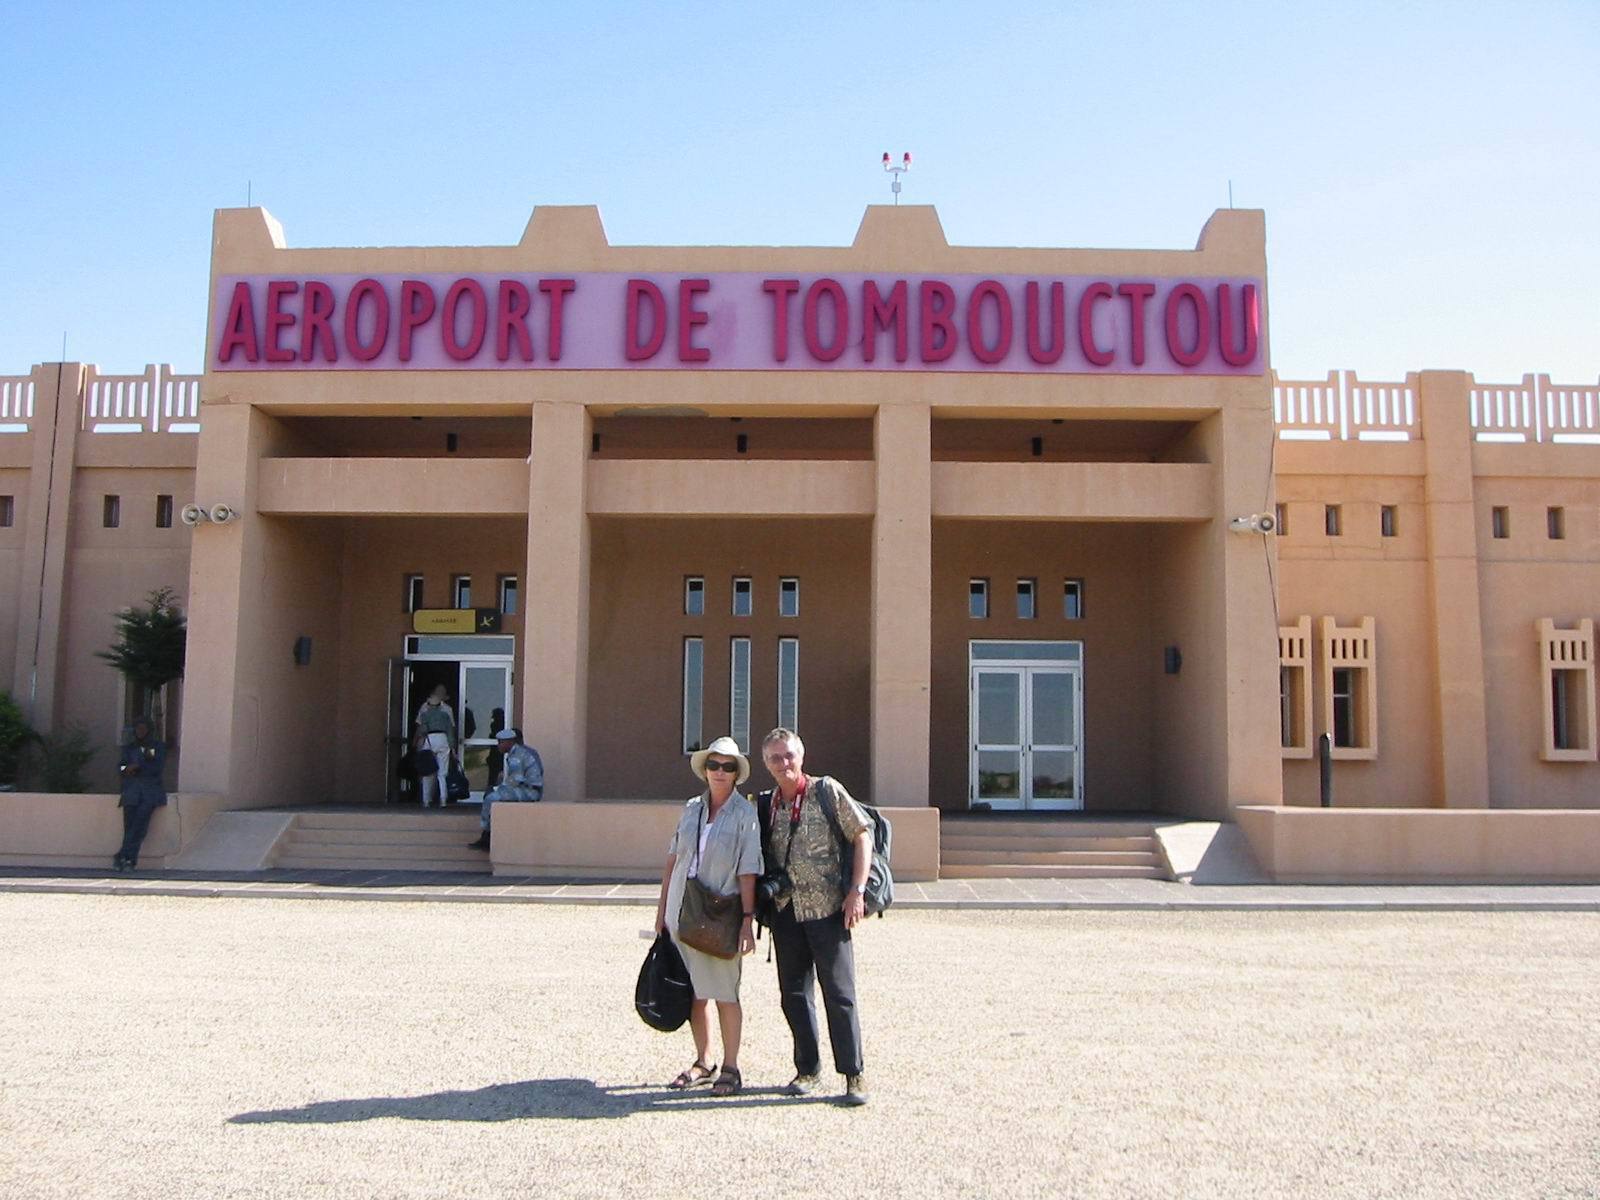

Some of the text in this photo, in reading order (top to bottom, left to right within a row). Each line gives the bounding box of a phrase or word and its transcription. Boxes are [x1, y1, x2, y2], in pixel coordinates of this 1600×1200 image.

[218, 278, 1258, 367] AEROPORT DE TOMBOUCTOU
